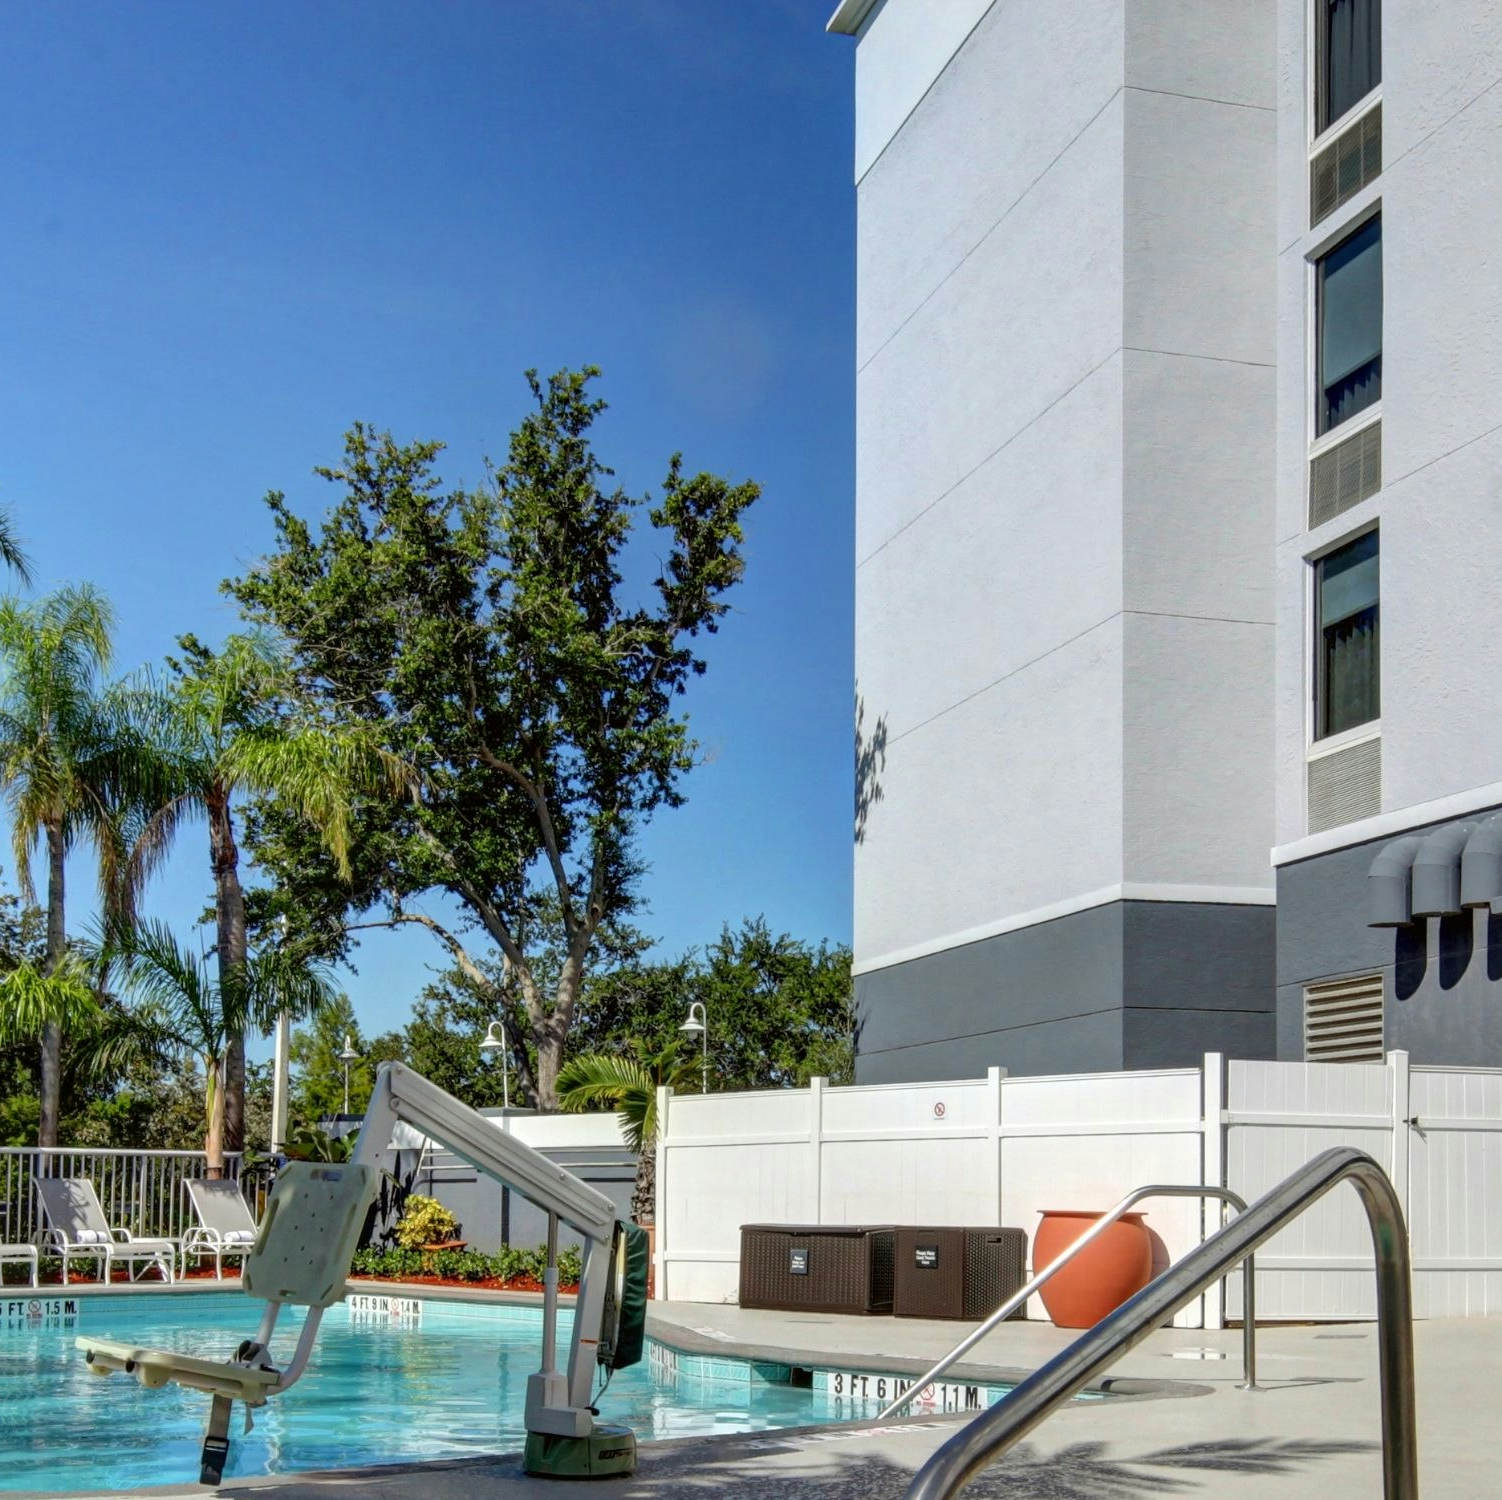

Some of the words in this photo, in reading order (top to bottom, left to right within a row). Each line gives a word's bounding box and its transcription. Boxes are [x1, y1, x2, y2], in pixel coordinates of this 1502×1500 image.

[45, 1301, 59, 1315] 1.5
[65, 1301, 77, 1314] M.
[352, 1297, 356, 1309] 4
[372, 1298, 377, 1310] 9
[835, 1373, 842, 1394] 3
[851, 1375, 869, 1398] FT.
[877, 1378, 886, 1398] 6
[941, 1383, 959, 1407] 1.1
[966, 1386, 981, 1409] M.
